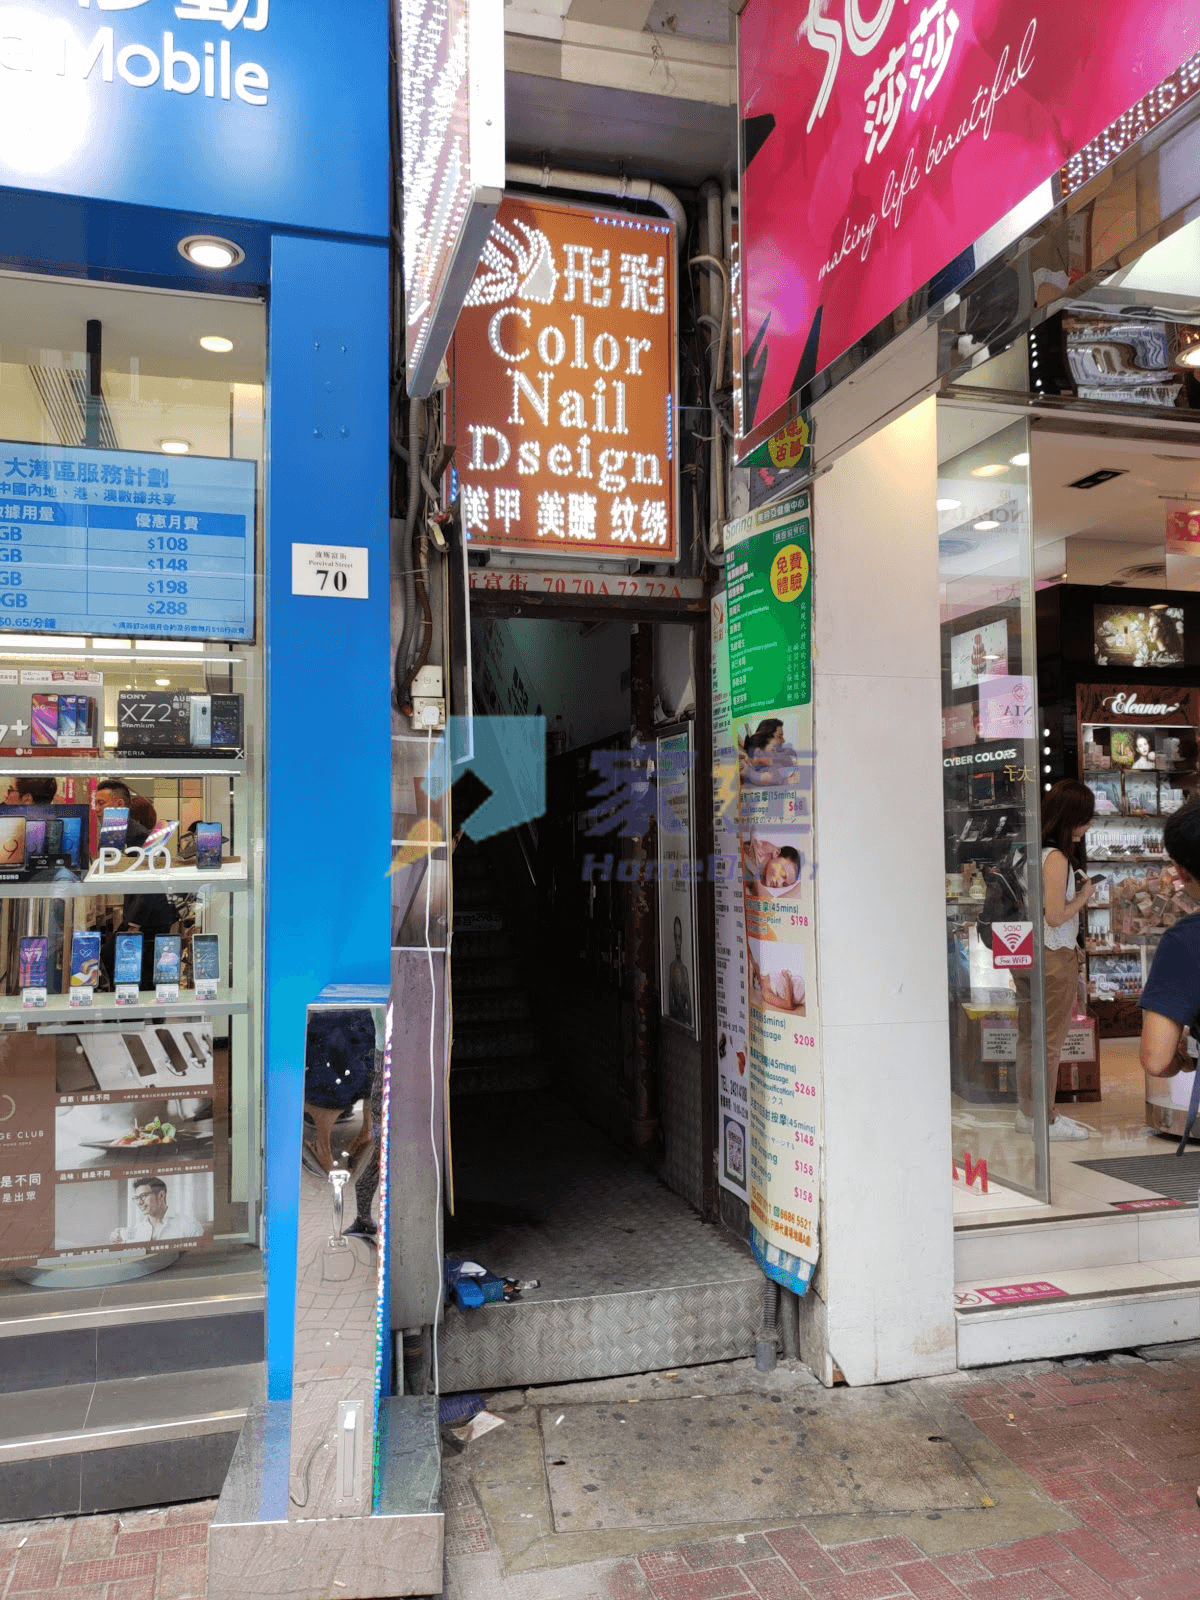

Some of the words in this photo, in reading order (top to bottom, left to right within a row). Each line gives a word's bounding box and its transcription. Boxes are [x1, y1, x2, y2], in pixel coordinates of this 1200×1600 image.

[56, 27, 270, 106] Mobile
[863, 0, 960, 164] 莎莎
[818, 214, 878, 283] making
[881, 148, 920, 229] life
[926, 18, 1038, 174] beautiful
[562, 243, 666, 315] 形彩
[487, 305, 652, 376] Color
[505, 368, 630, 435] Nail
[467, 424, 664, 492] Dseign
[4, 456, 170, 489] 大灣區服務計劃
[147, 536, 189, 552] $108
[308, 560, 334, 568] Percival
[314, 550, 347, 560] 波斯富街
[776, 550, 803, 577] 免費
[147, 557, 189, 573] $148
[147, 579, 189, 595] $198
[316, 569, 348, 592] 70
[543, 576, 567, 594] 70
[571, 578, 610, 596] 70A
[147, 600, 189, 616] $288
[120, 703, 172, 722] XZ2
[1101, 691, 1181, 716] Eleanor
[943, 754, 974, 768] CYBER
[974, 748, 1018, 764] COLORS
[788, 800, 804, 812] $68
[99, 846, 172, 876] P20
[790, 914, 809, 927] $198
[24, 951, 43, 962] Y7
[1011, 956, 1028, 964] WiFi
[793, 1032, 815, 1048] $208
[794, 1081, 816, 1097] $268
[17, 1129, 45, 1139] CLUB
[794, 1130, 814, 1147] $148
[794, 1159, 814, 1177] $158
[0, 1173, 42, 1189] 是不同
[793, 1185, 813, 1204] $158
